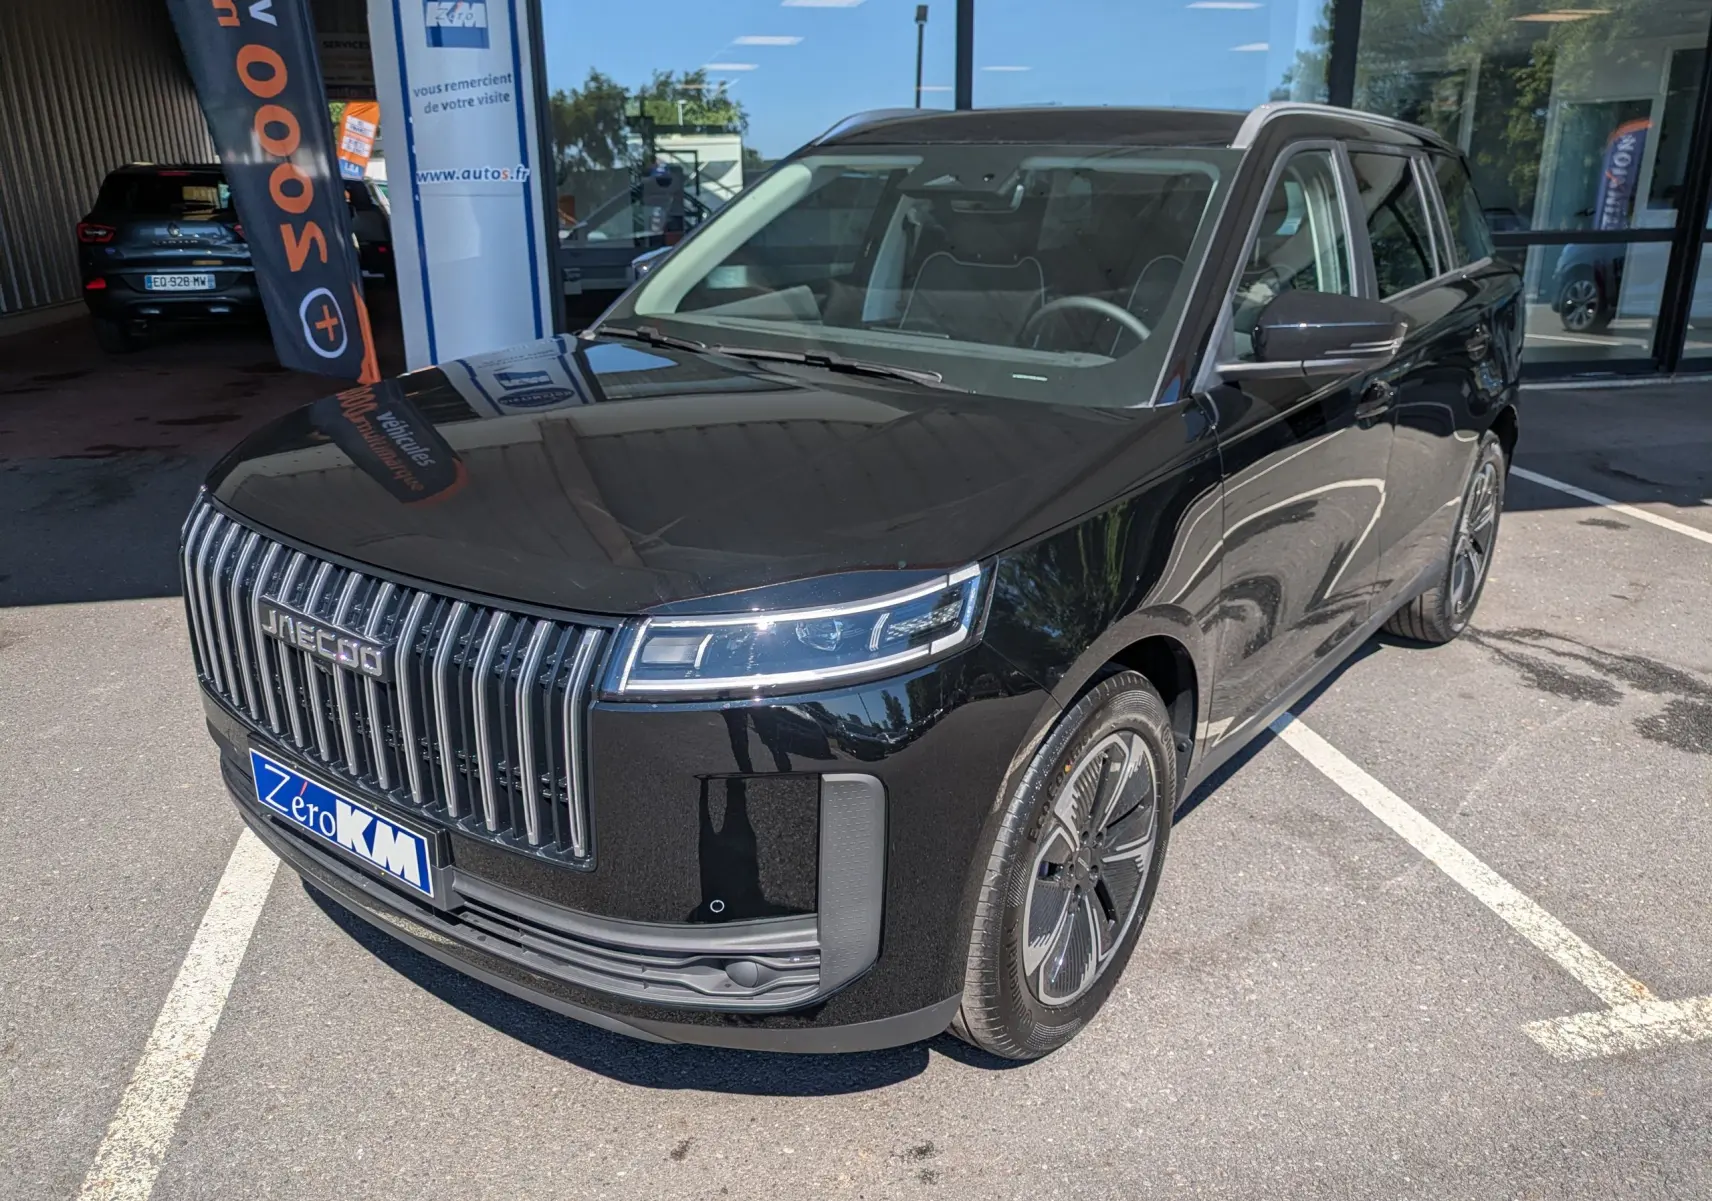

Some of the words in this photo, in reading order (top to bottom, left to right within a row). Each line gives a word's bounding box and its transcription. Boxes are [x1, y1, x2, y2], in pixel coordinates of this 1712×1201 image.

[413, 84, 443, 97] vous
[445, 73, 513, 92] remercient
[424, 101, 439, 115] de
[441, 96, 475, 111] votre
[478, 91, 511, 106] visite
[416, 165, 530, 183] www.autos.fr
[262, 609, 383, 677] JAECOO
